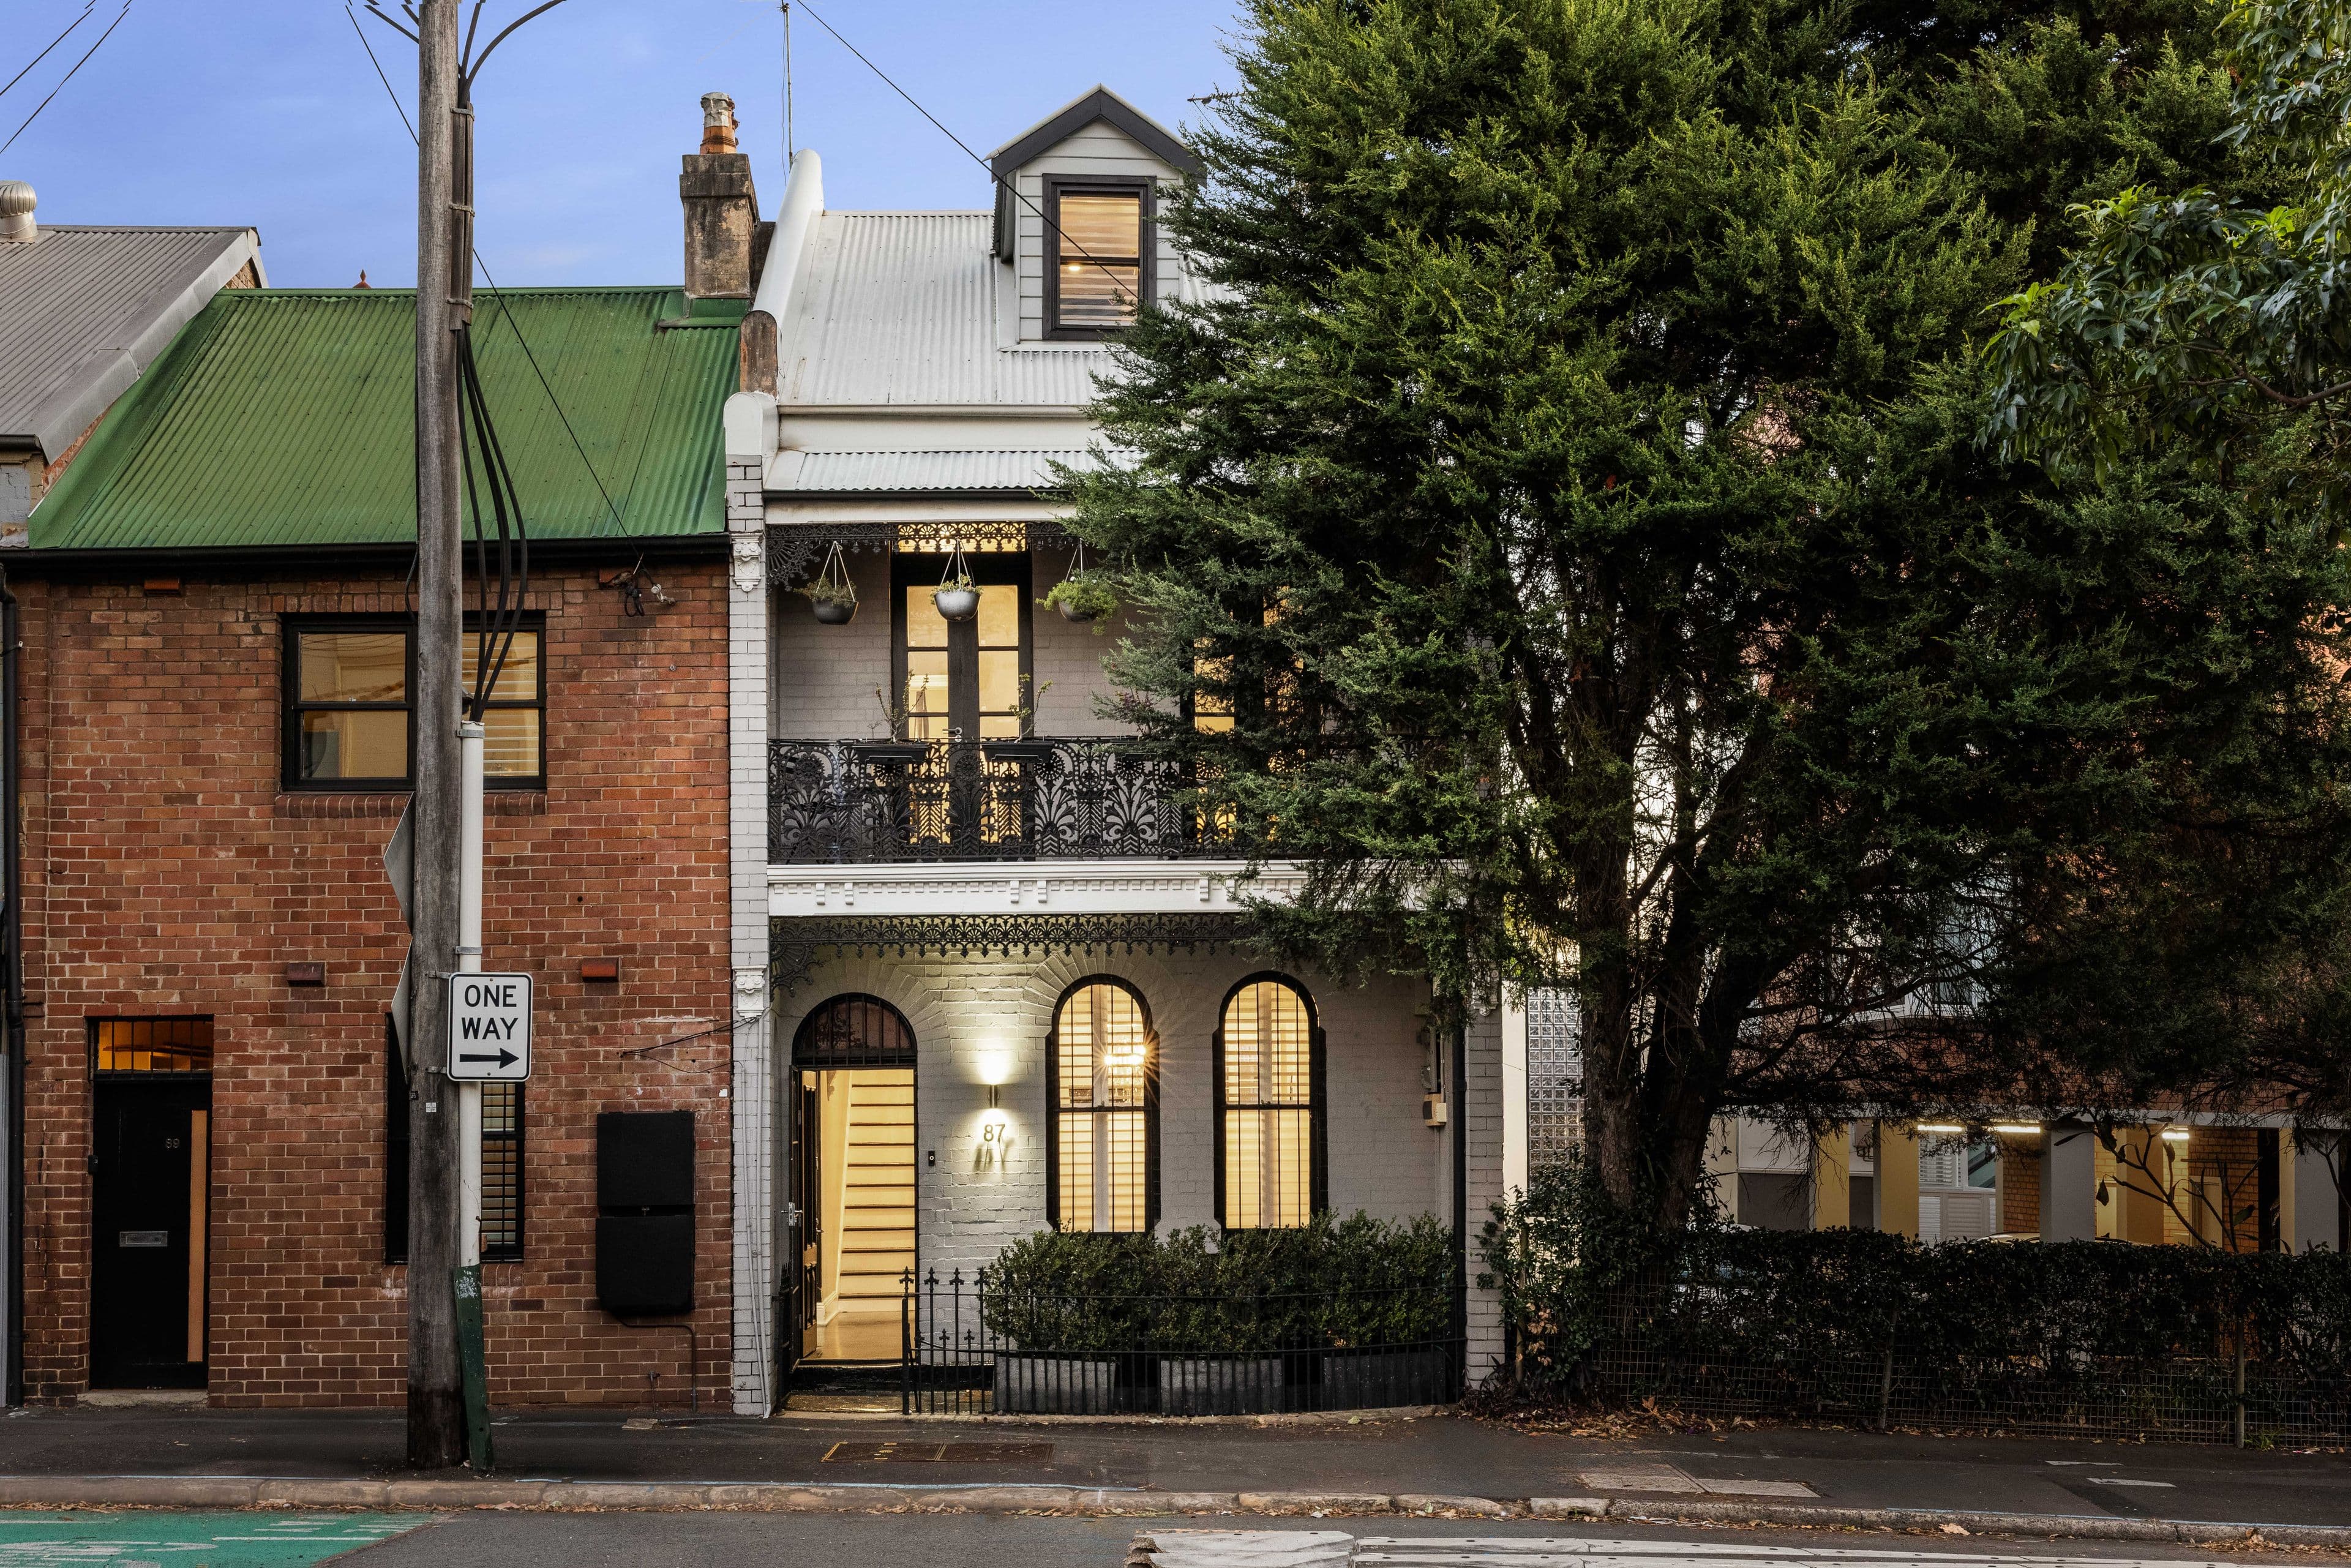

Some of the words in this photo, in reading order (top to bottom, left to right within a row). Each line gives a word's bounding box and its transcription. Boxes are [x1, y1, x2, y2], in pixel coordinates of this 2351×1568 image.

[464, 985, 517, 1007] ONE
[461, 1017, 519, 1040] WAY
[165, 1138, 180, 1149] 89
[983, 1123, 1005, 1143] 87
